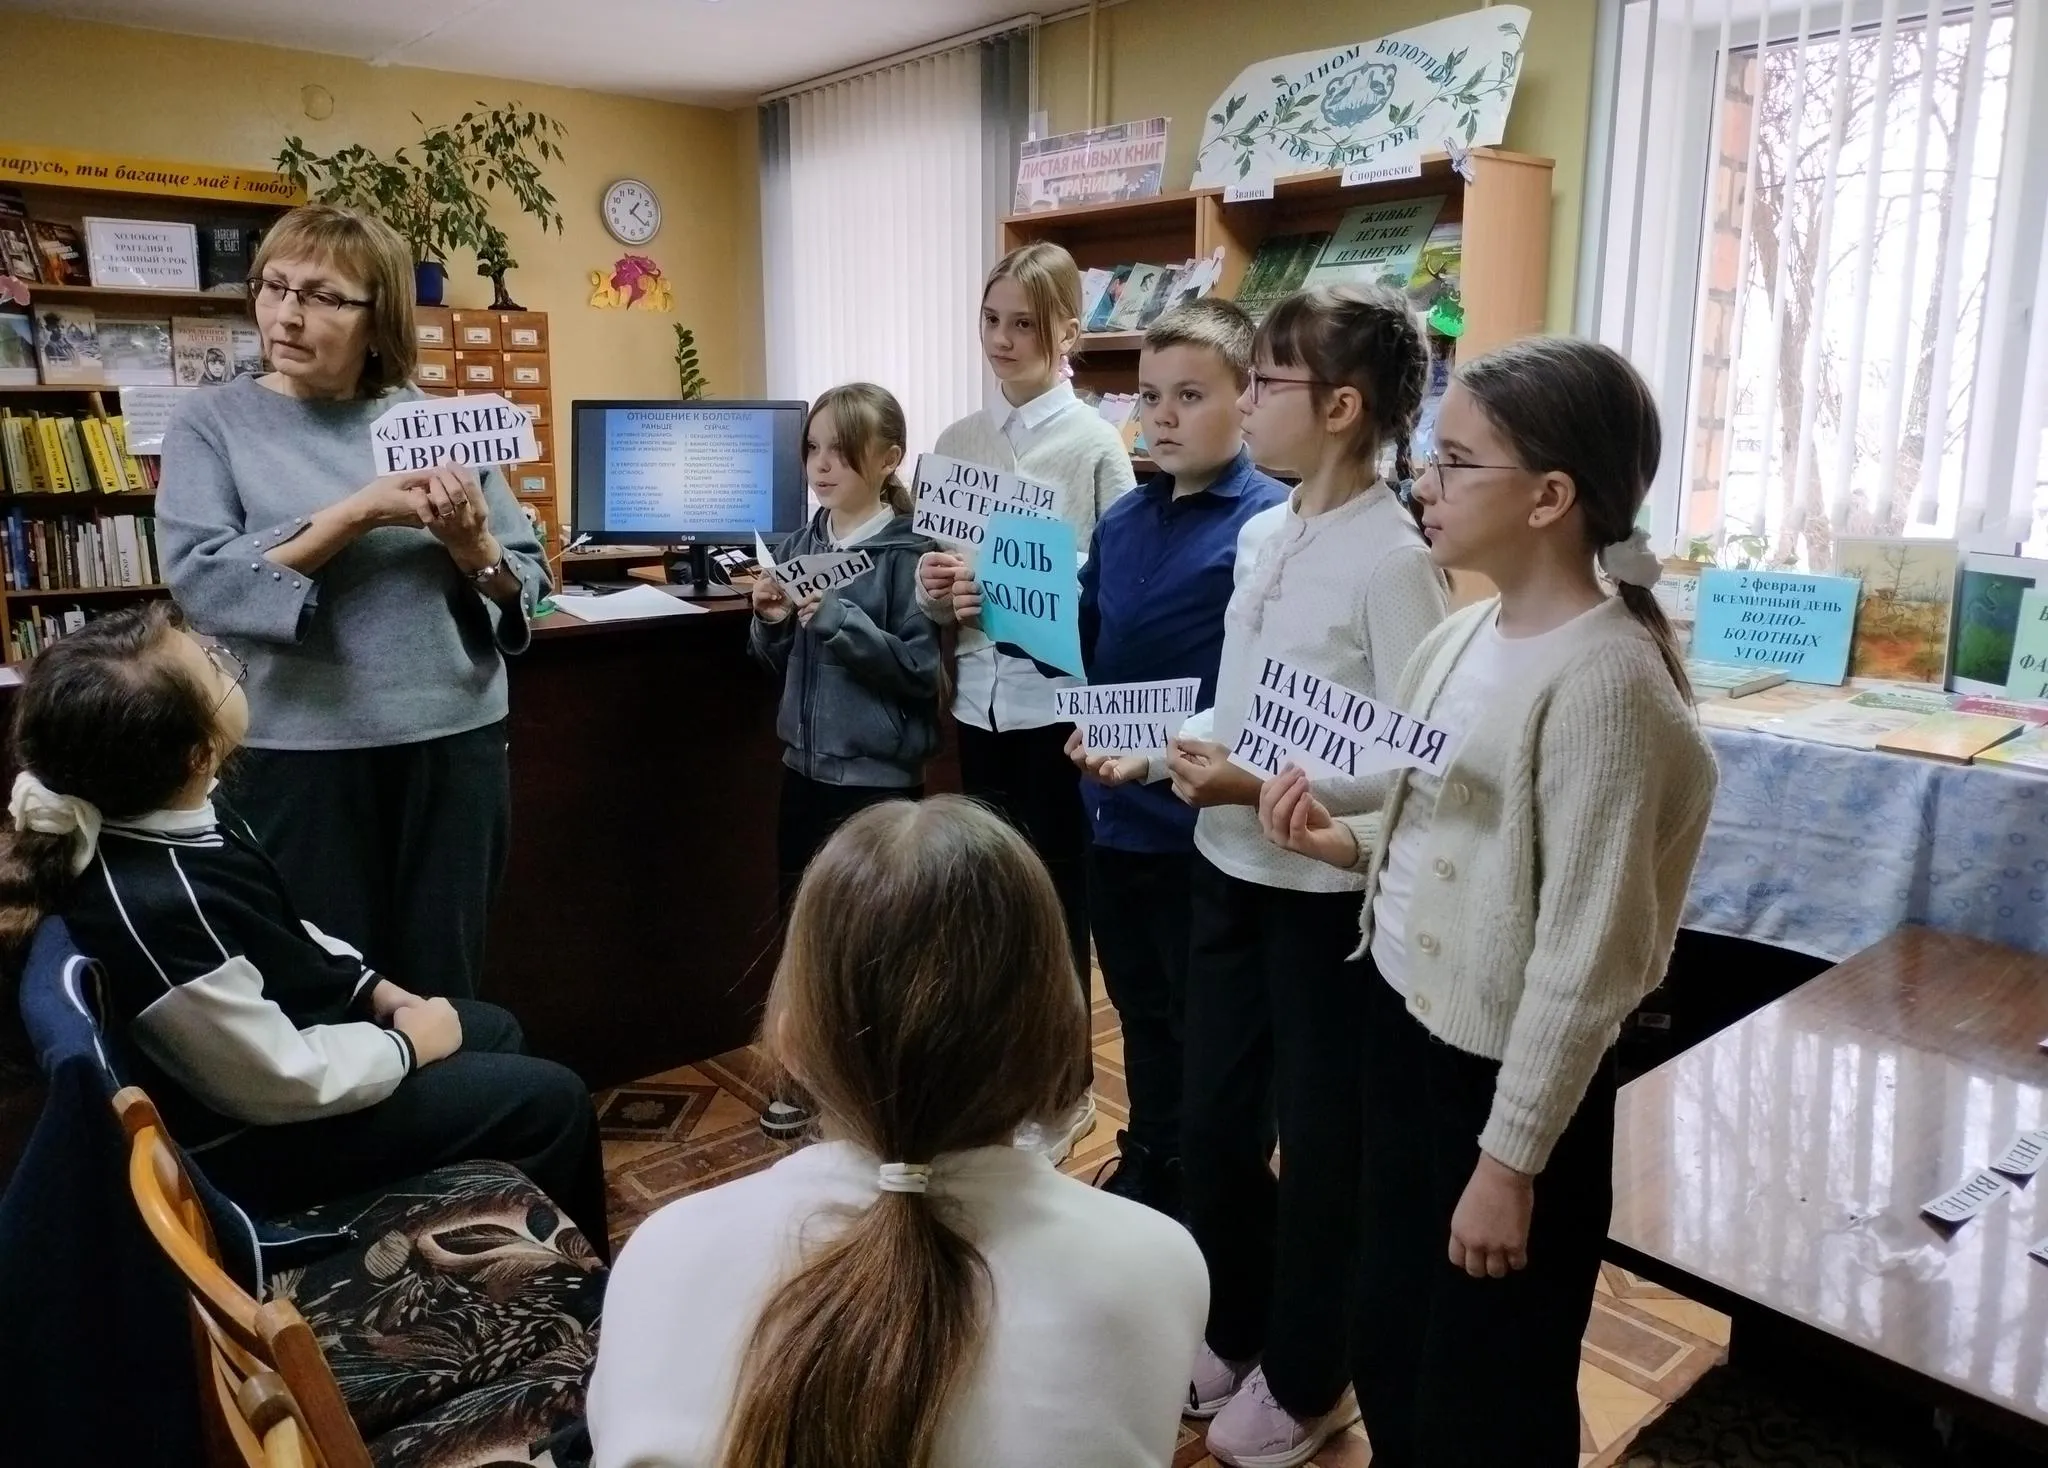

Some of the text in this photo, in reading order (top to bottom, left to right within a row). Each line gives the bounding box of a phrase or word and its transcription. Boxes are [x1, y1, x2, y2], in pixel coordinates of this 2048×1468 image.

[1258, 39, 1457, 124] В ВОДНОМ БОЛОТНОМ
[1022, 141, 1164, 180] ЛИСТАЯ НОВЫХ КНИГ
[1278, 127, 1420, 169] ГОСУДАРСТВЕ
[75, 162, 108, 178] ты
[114, 164, 190, 187] багацце
[193, 174, 230, 190] маё
[232, 175, 240, 190] і
[1349, 165, 1414, 182] Споровские
[1360, 206, 1422, 224] ЖИВЫЕ
[1350, 225, 1414, 243] ЛЁГКИЕ
[1335, 243, 1412, 262] ПЛАНЕТЫ
[376, 406, 527, 443] «ЛЁГКИЕ»
[627, 412, 752, 421] ОТНОШЕНИЕ К БОЛОТАМ
[641, 423, 672, 431] РАНЬШЕ
[385, 436, 521, 473] ЕВРОПЫ
[946, 463, 1055, 510] ДОМ ДЛЯ
[992, 536, 1053, 573] РОЛЬ
[795, 554, 870, 599] ВОДЫ
[1740, 576, 1816, 594] 2 февраля
[982, 580, 1060, 622] БОЛОТ
[1712, 593, 1842, 613] ВСЕМИРНЫЙ ДЕНЬ
[1741, 611, 1806, 627] ВОДНО-
[1723, 627, 1822, 647] БОЛОТНЫХ
[1734, 645, 1806, 665] УГОДИЙ
[1056, 685, 1195, 715] УВЛАЖНИТЕЛИ
[1259, 657, 1449, 766] НАЧАЛО ДЛЯ
[1087, 722, 1168, 751] ВОЗДУХА
[1247, 694, 1365, 777] МНОГИХ
[1232, 728, 1287, 776] РЕК
